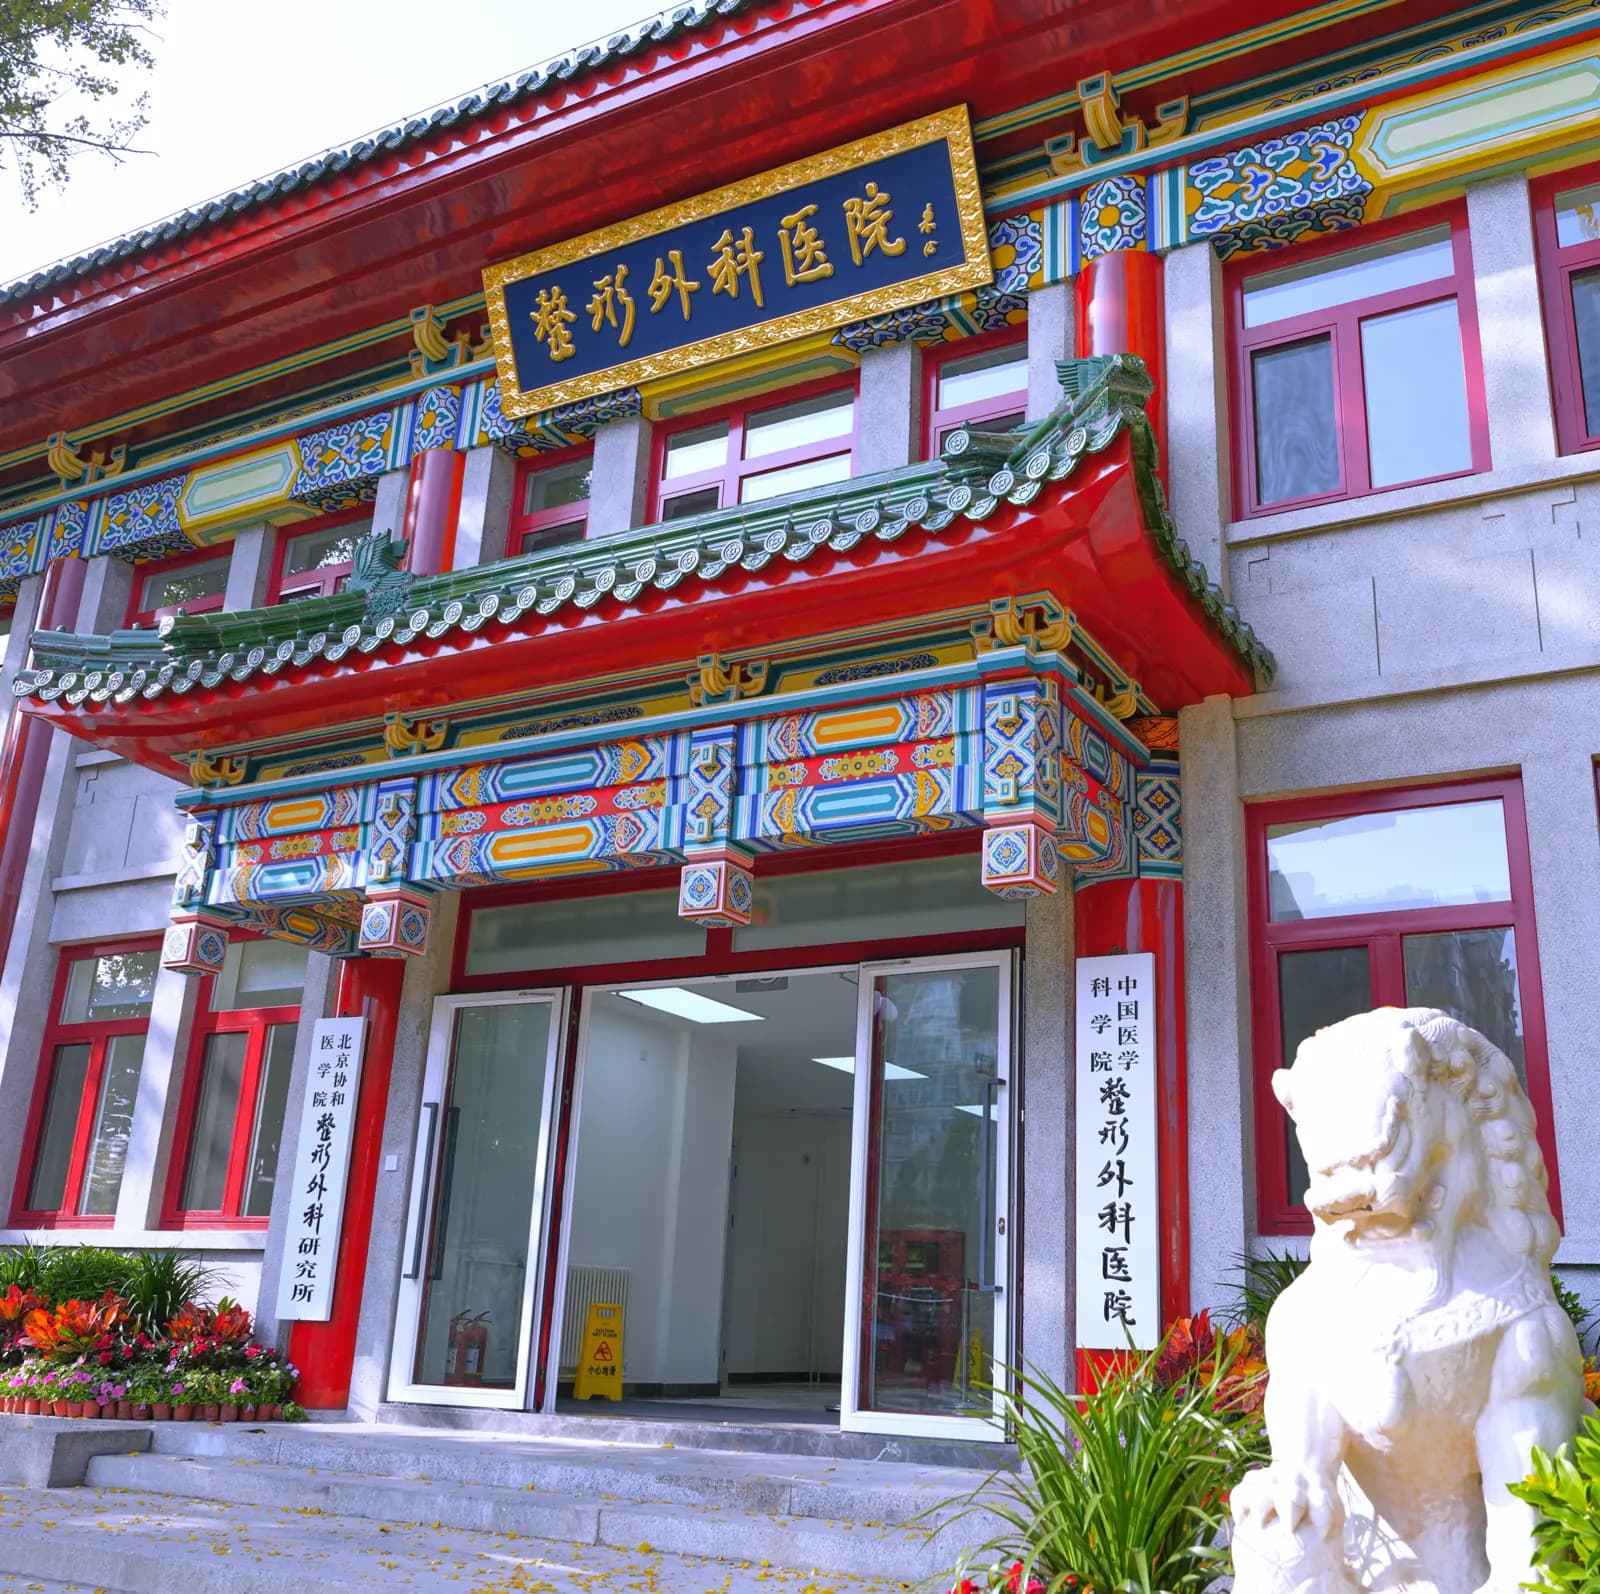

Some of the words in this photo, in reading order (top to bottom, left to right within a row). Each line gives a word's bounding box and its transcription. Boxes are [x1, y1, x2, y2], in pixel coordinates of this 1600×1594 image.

[529, 181, 907, 362] 整形外科医院
[312, 1034, 335, 1108] 医学院
[330, 1033, 353, 1107] 北京协和
[1090, 976, 1113, 1073] 科学院
[1117, 975, 1140, 1071] 中国医学
[291, 1112, 337, 1304] 整形外科研究所
[1096, 1076, 1137, 1326] 整形外科医院
